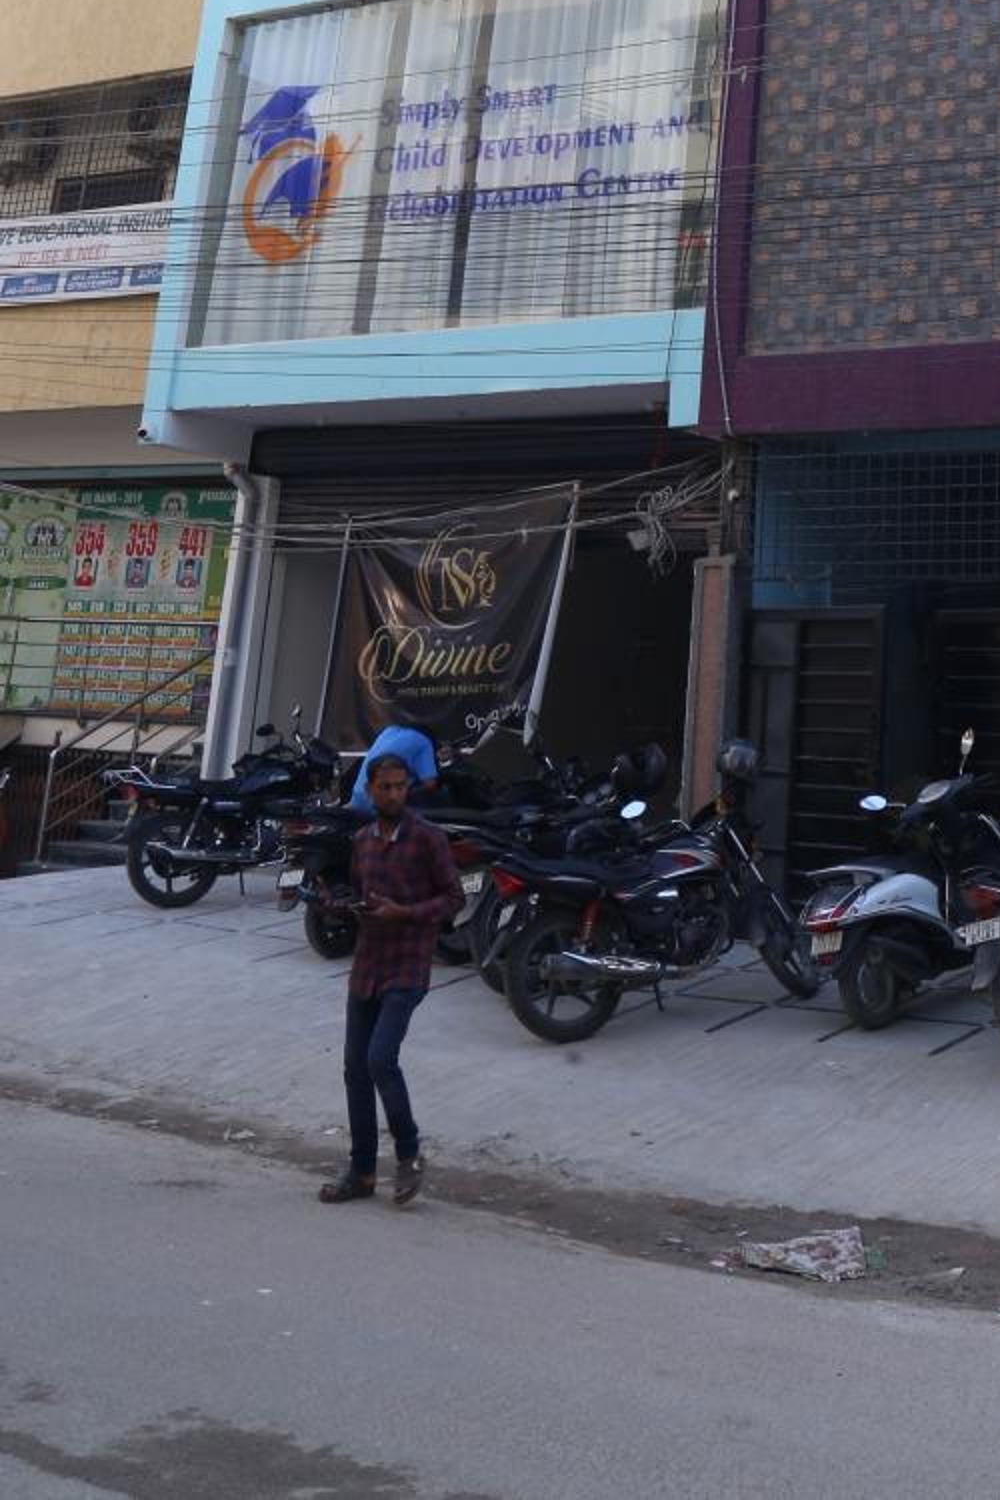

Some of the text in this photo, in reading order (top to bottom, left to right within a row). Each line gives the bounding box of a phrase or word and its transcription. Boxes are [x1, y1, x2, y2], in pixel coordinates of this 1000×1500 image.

[125, 517, 159, 556] 359
[178, 526, 207, 556] 441
[358, 625, 512, 703] Divine
